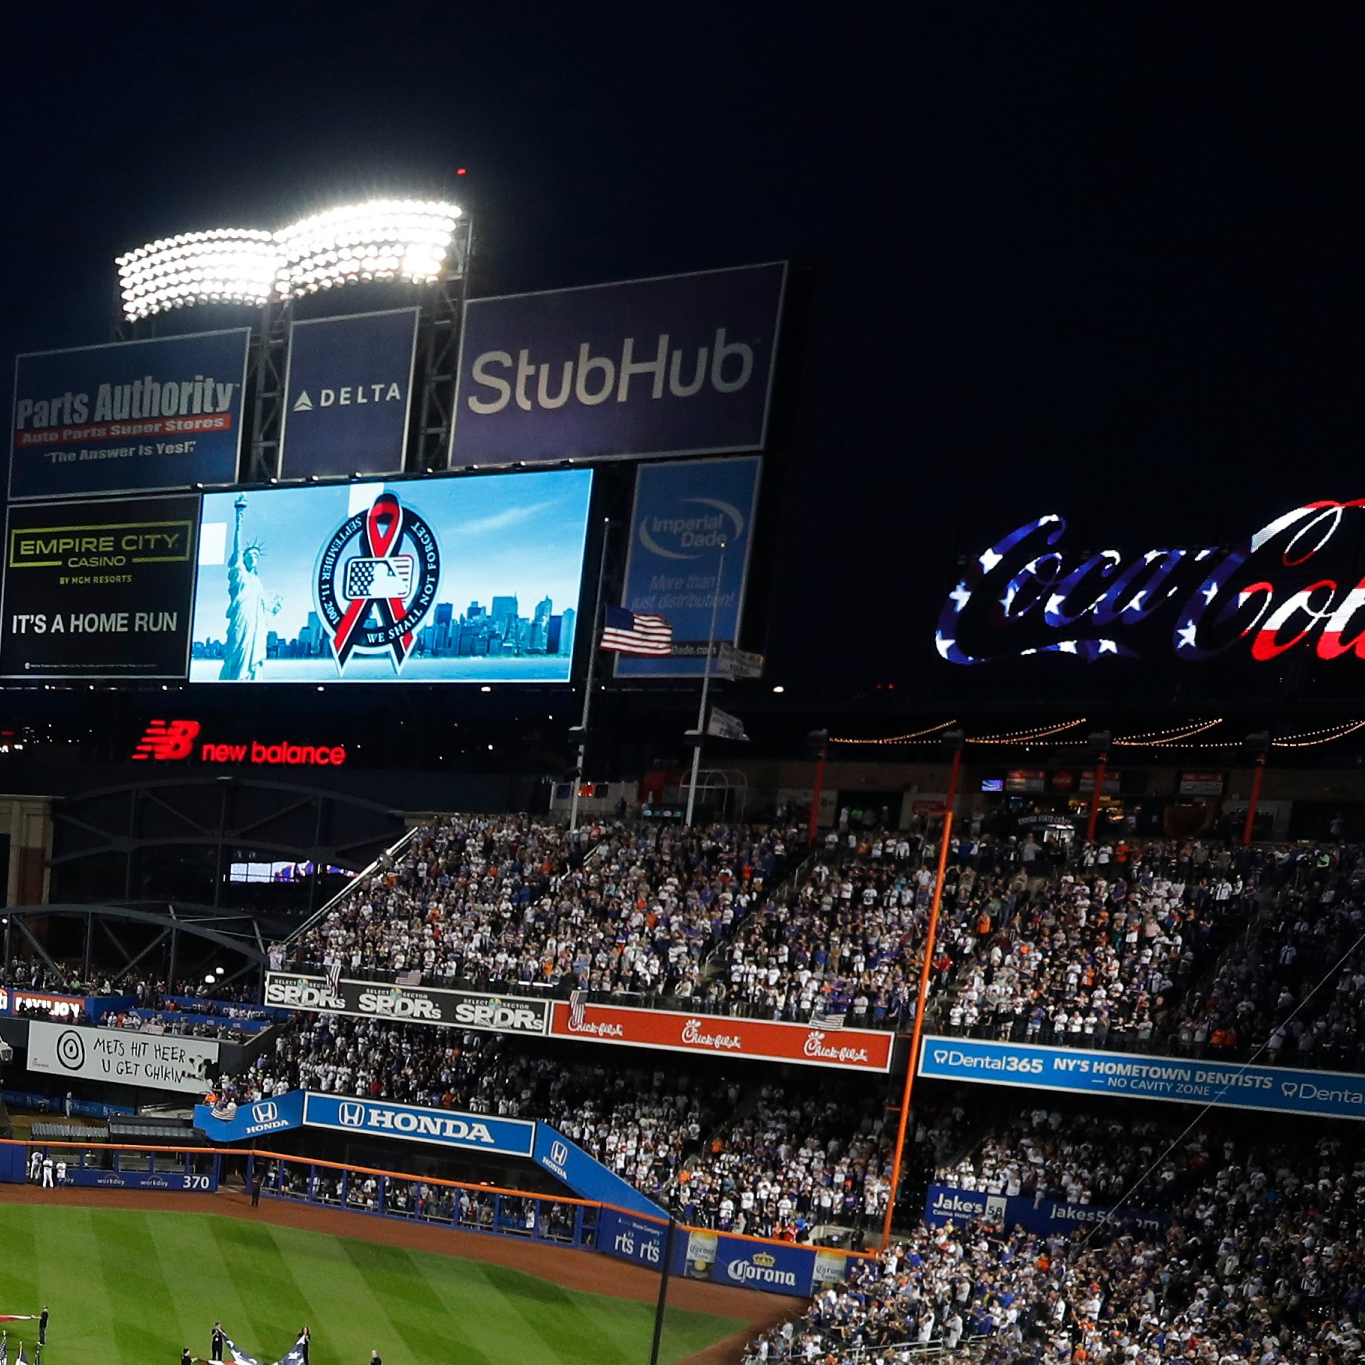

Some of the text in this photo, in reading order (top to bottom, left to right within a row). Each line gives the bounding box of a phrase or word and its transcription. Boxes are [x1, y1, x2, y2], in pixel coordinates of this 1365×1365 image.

[468, 327, 755, 415] StubHub
[17, 374, 234, 430] Parts Authority
[320, 382, 401, 408] DELTA
[110, 416, 225, 436] Super Stores
[653, 513, 724, 536] Imperial
[20, 532, 180, 555] EMPIRE CITY
[321, 516, 363, 582] SEPTEMBER
[681, 531, 727, 548] Dade
[67, 555, 126, 568] CASINO
[59, 575, 133, 585] BY RESORTS
[367, 520, 437, 644] WE SHALL NOT FORGET
[12, 611, 178, 634] IT'S A HOME RUN
[201, 740, 347, 766] new balance
[94, 1037, 185, 1063] METS HIT HEER
[101, 1059, 184, 1084] U GET CHIKIN
[948, 1050, 1274, 1089] Dental365 NY'S HOMETOWN DENTISTS
[1107, 1077, 1211, 1097] NO CAVITY ZONE
[246, 1119, 290, 1134] HONDA
[368, 1108, 494, 1144] HONDA
[542, 1156, 568, 1181] HONDA
[182, 1175, 210, 1189] 370
[932, 1193, 983, 1215] Jake's
[614, 1232, 635, 1256] rts
[640, 1240, 661, 1263] rts
[727, 1258, 797, 1287] Corona
